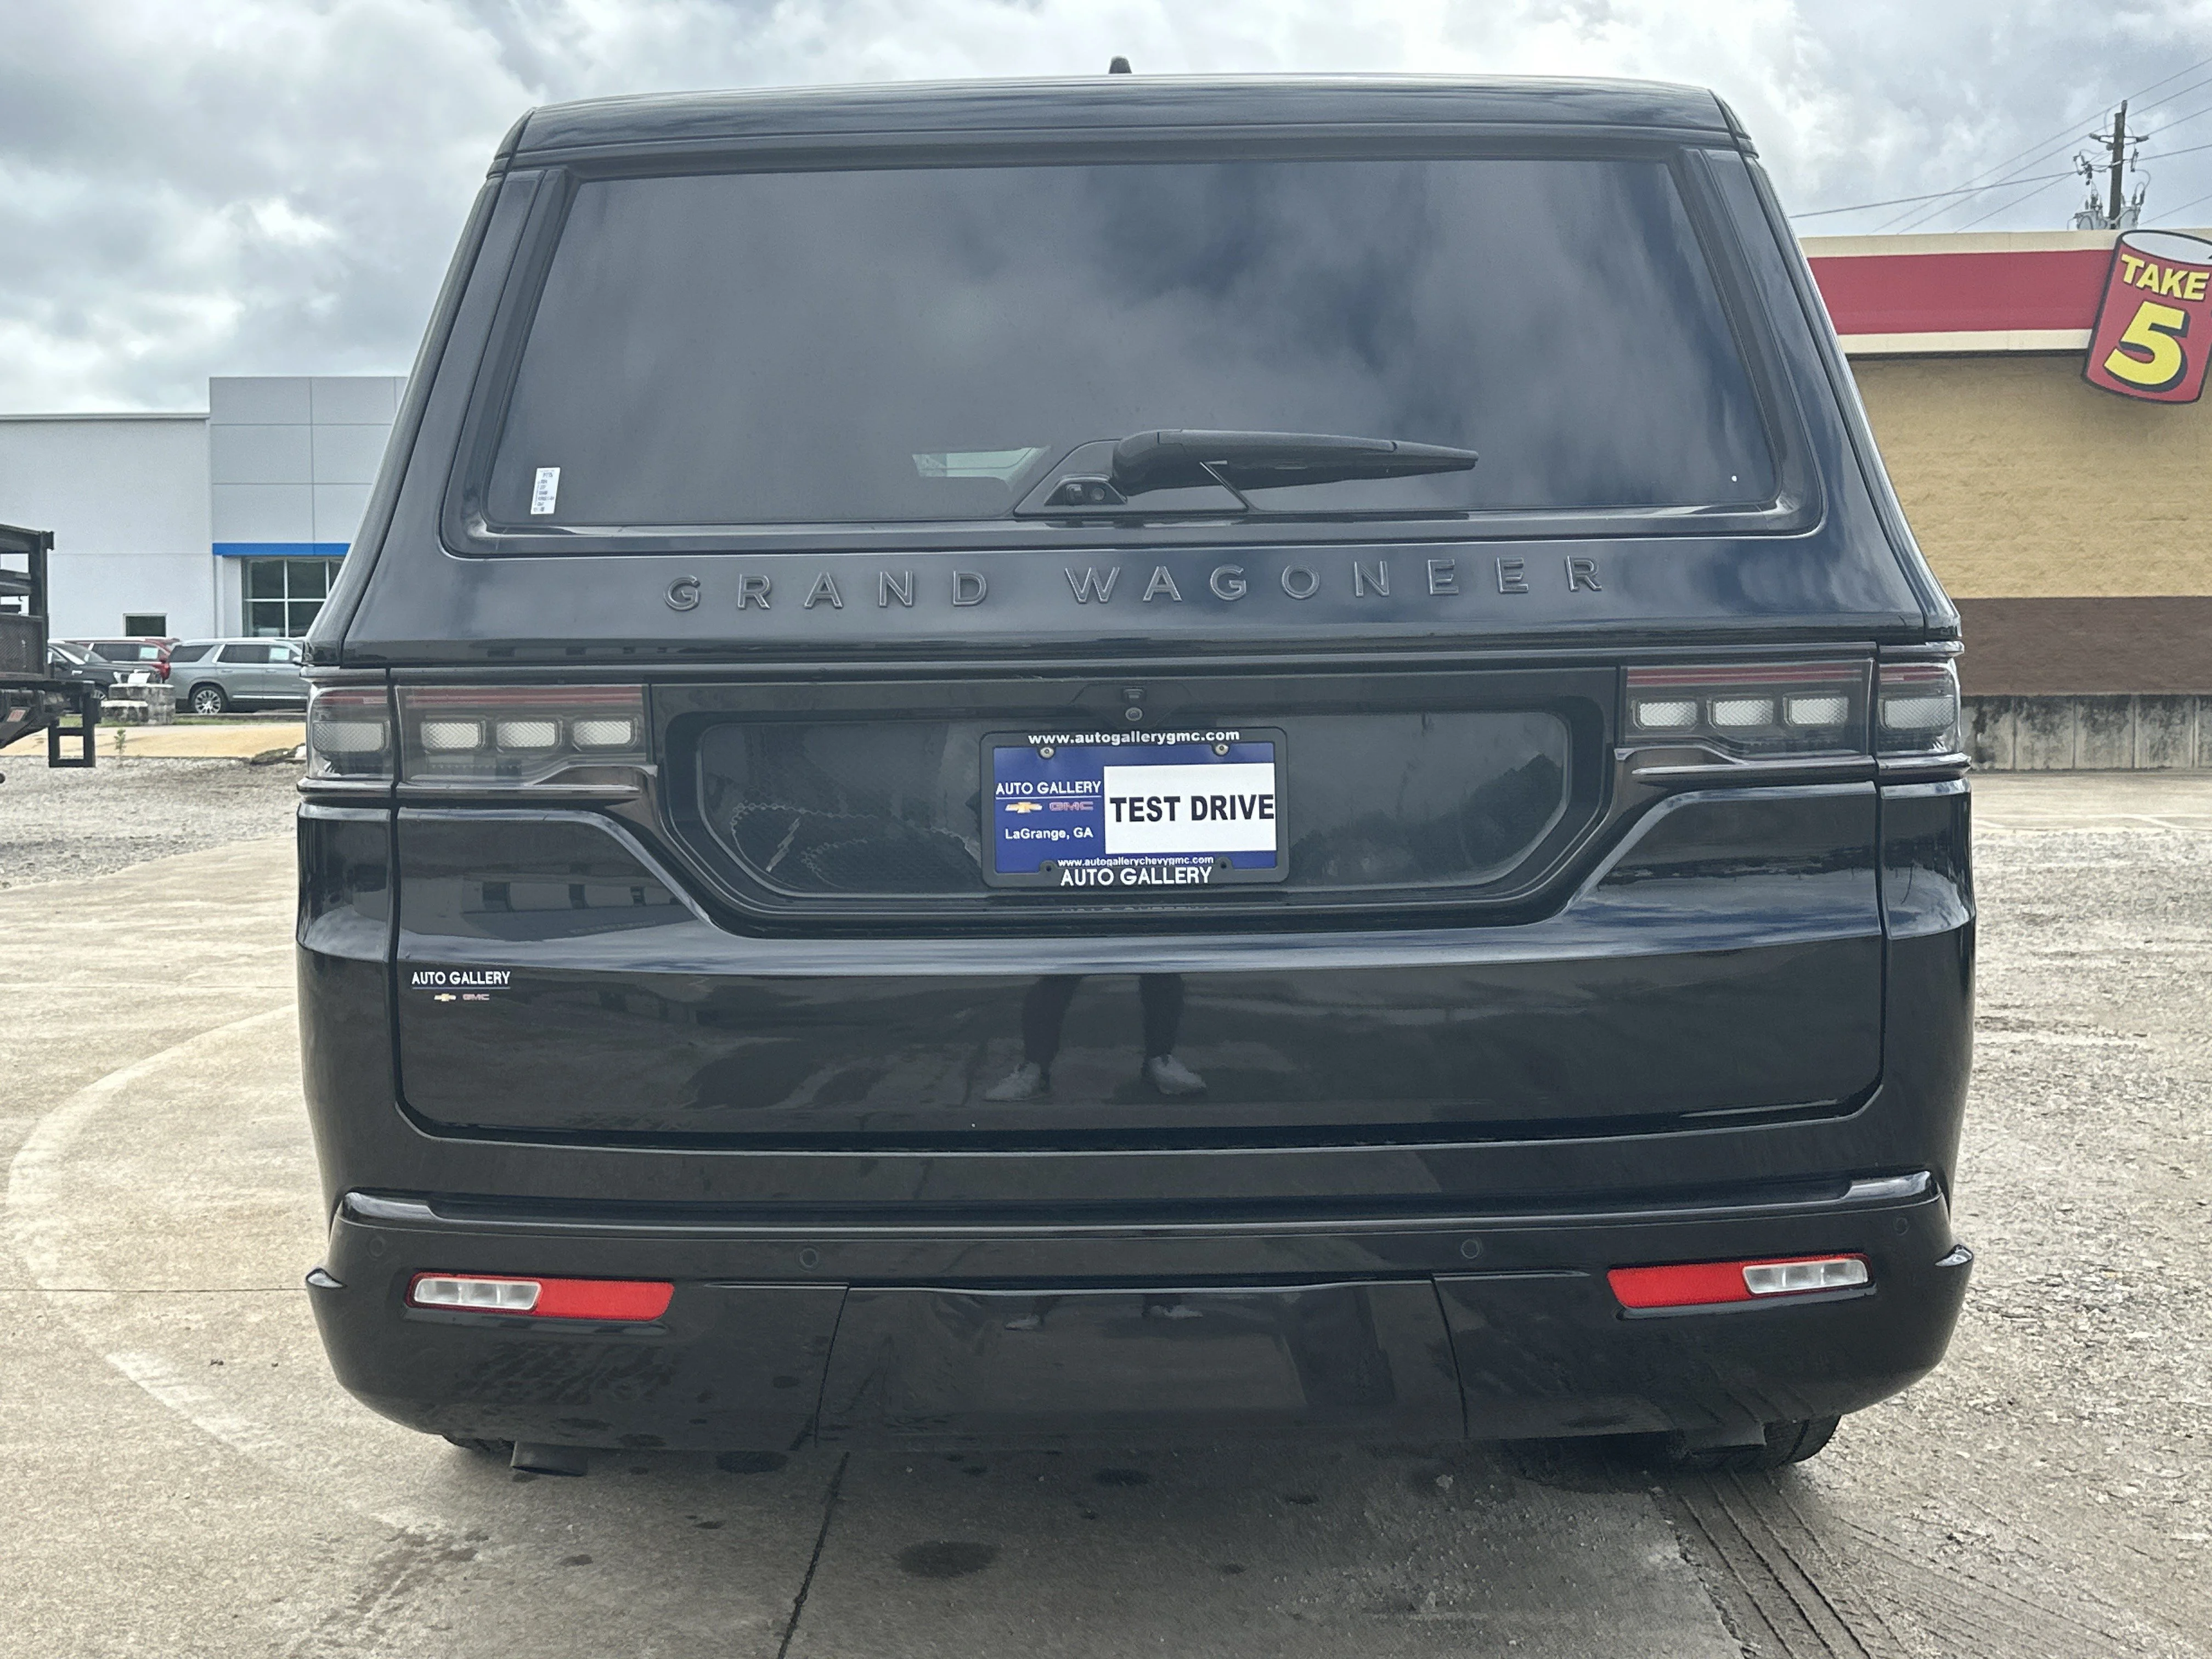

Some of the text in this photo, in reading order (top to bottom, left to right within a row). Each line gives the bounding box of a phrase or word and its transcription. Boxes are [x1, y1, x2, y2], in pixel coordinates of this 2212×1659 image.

[2120, 253, 2210, 301] TAKE
[2103, 301, 2187, 386] 5
[663, 555, 1602, 611] GRAND WAGONEER
[1028, 730, 1240, 746] www.autogallerygmc.com
[995, 780, 1102, 795] AUTO GALLERY
[1049, 800, 1094, 811] GMC
[1109, 794, 1275, 822] TEST DRIVE
[1005, 826, 1093, 841] LaGrange, GA
[1058, 856, 1214, 867] www.autogallerychevygmc.com
[1060, 866, 1212, 886] AUTO GALLERY
[411, 970, 511, 985] AUTO GALLERY
